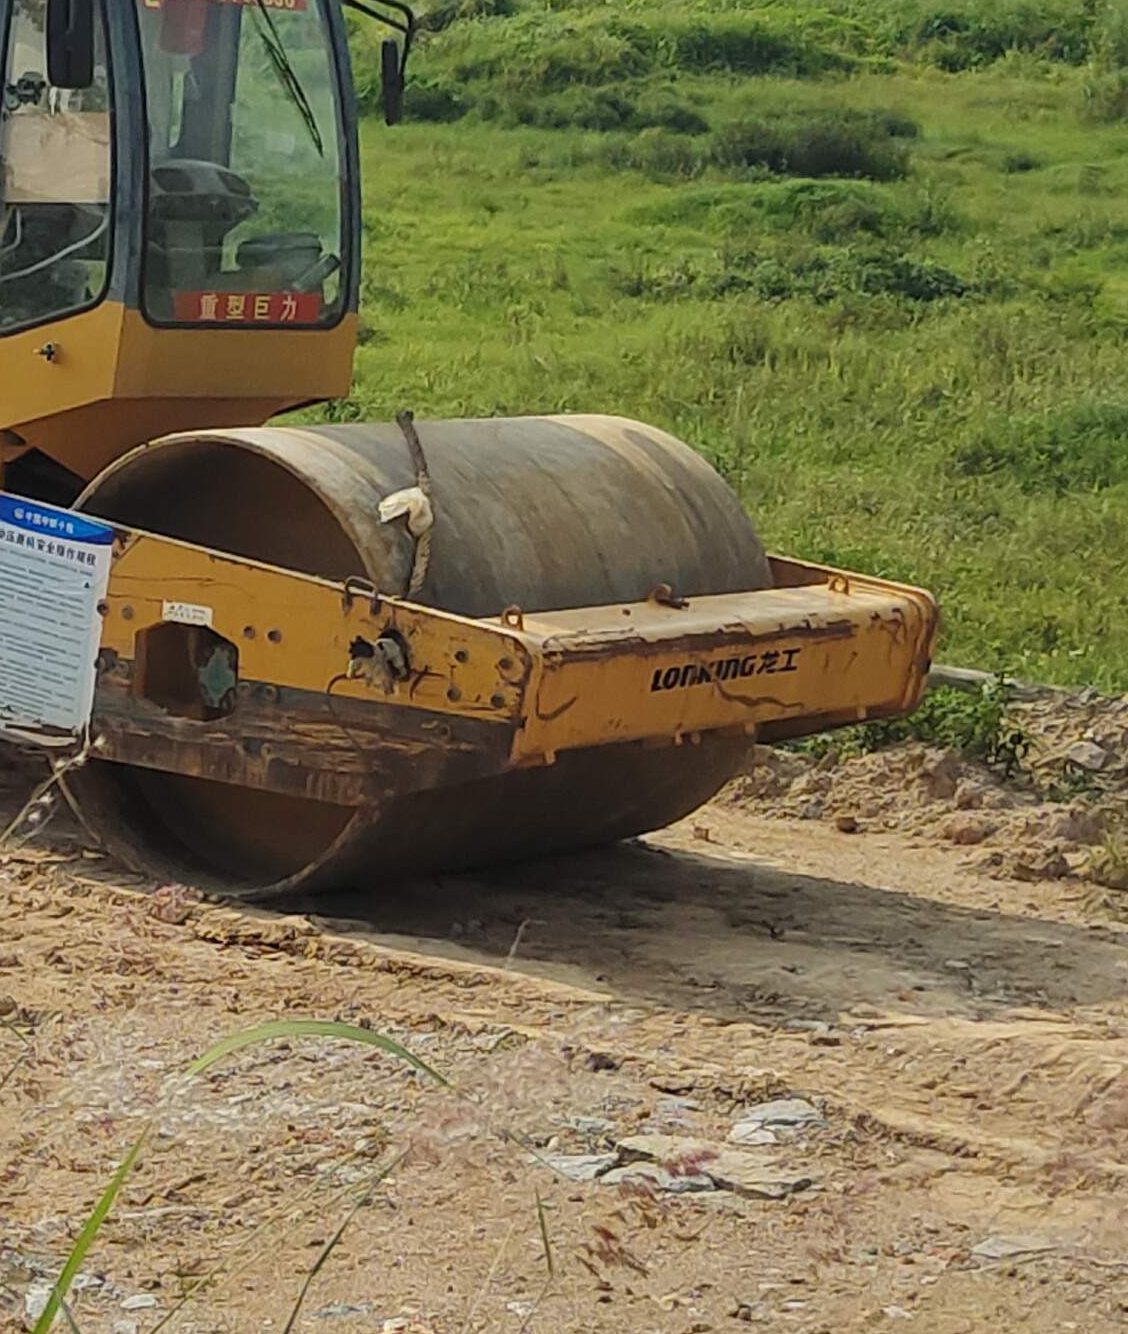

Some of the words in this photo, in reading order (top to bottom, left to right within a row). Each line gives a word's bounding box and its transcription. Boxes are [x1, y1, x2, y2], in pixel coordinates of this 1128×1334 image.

[199, 293, 297, 321] 重型巨力
[756, 648, 801, 675] 龙工
